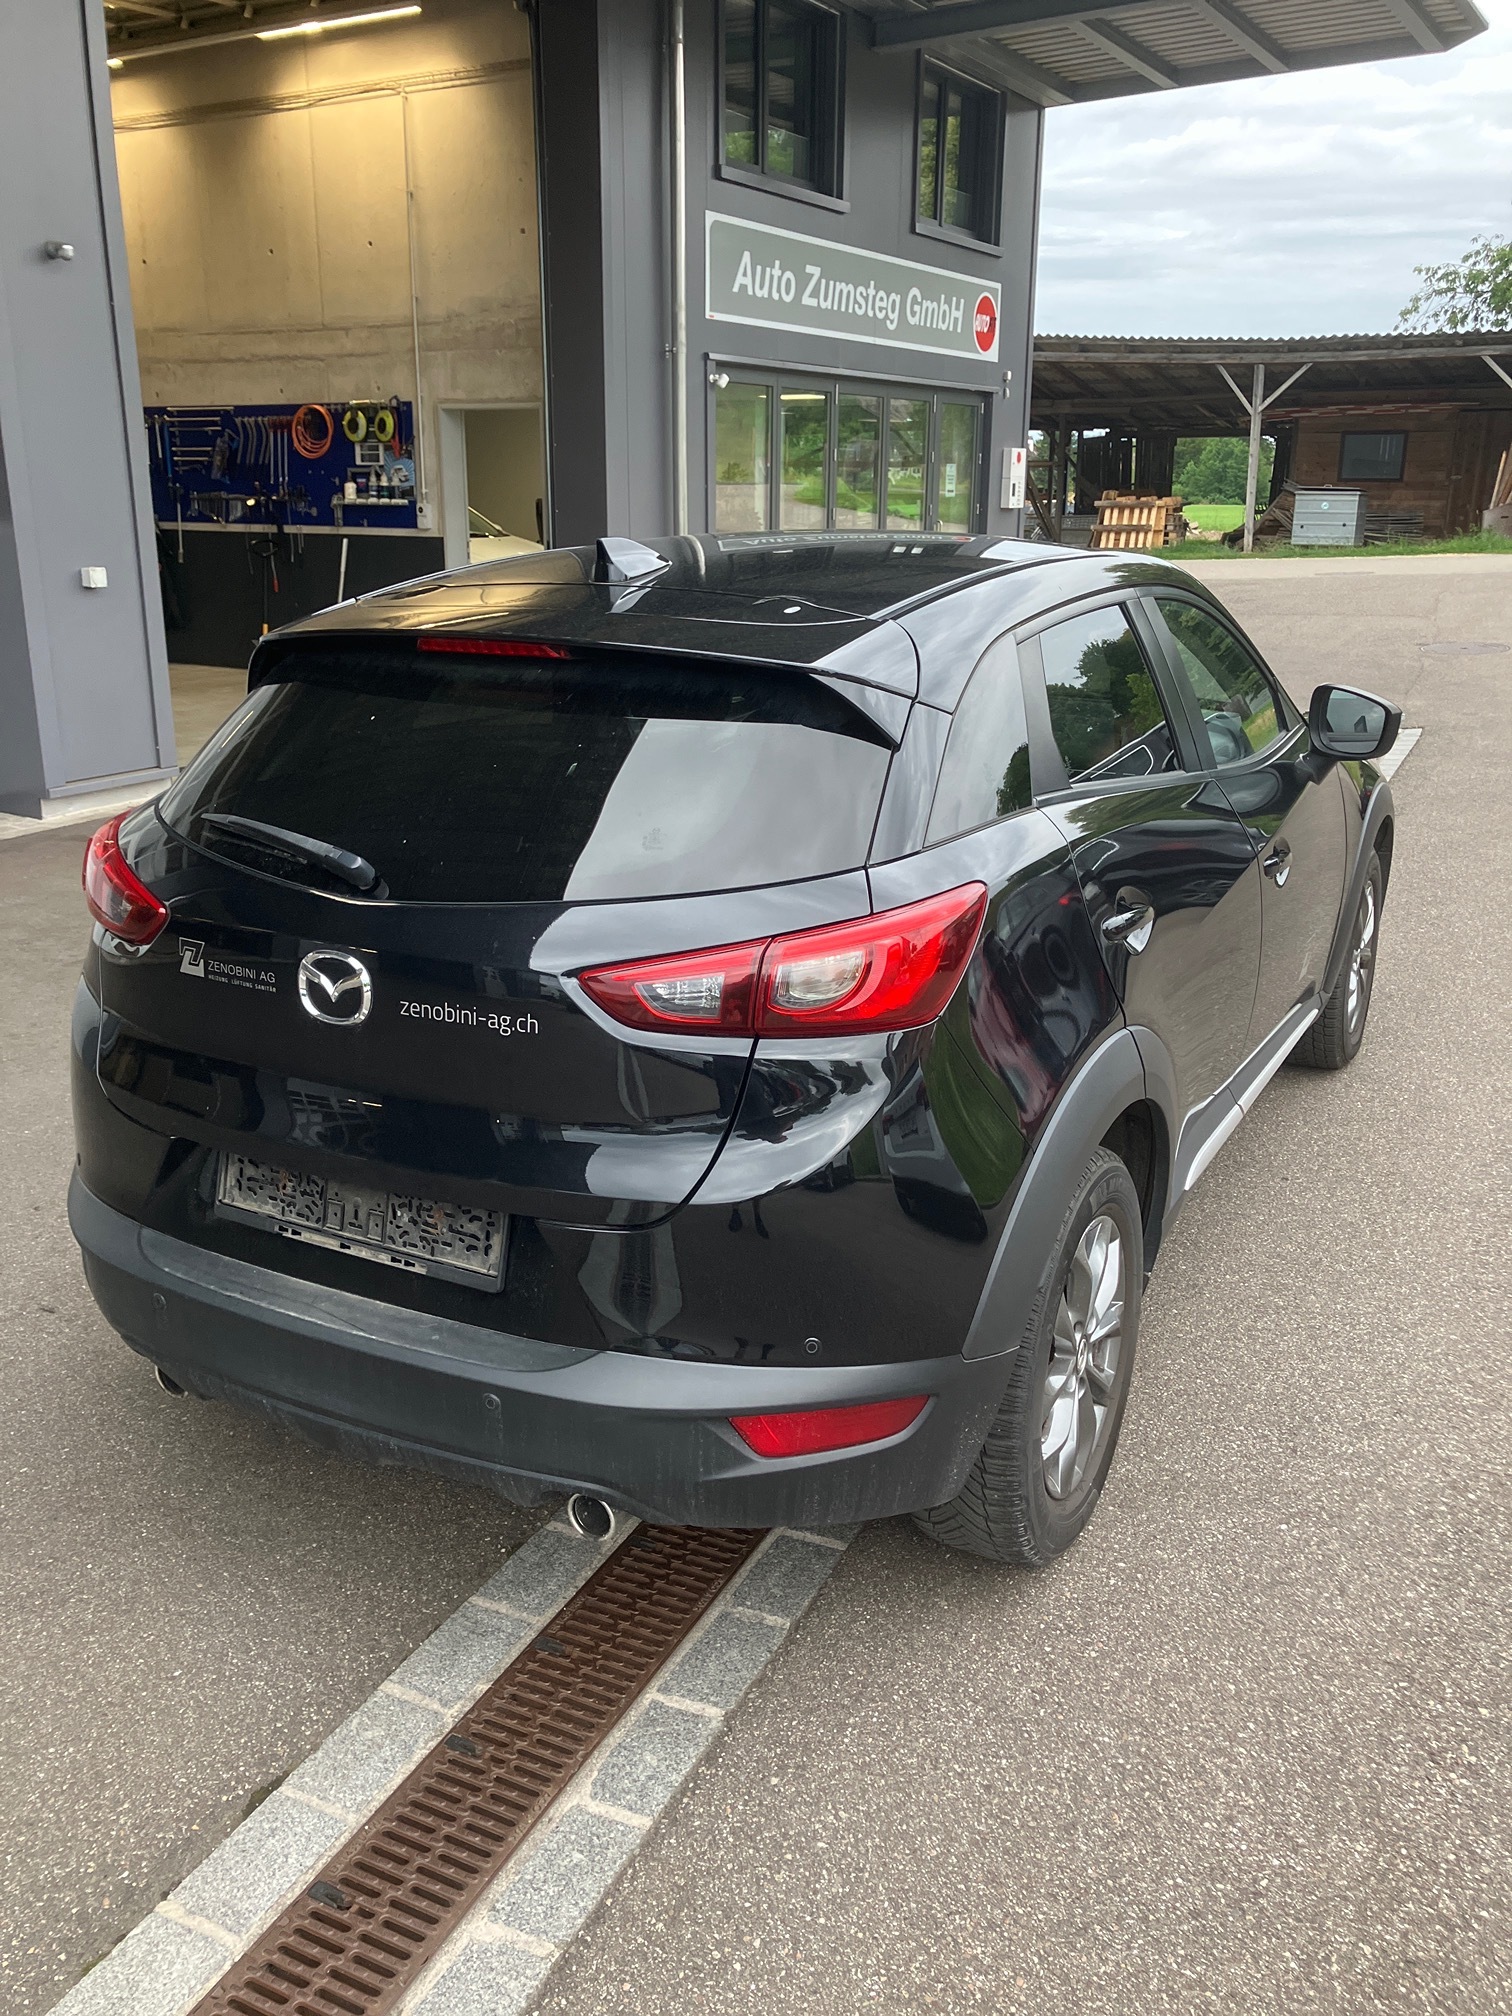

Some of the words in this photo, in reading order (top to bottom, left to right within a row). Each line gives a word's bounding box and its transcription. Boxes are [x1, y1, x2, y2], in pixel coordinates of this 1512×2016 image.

[732, 250, 796, 302] Auto
[802, 265, 900, 330] Zumsteg
[906, 287, 964, 333] GmbH
[208, 960, 256, 979] ZENOBINI
[260, 971, 276, 983] AG
[400, 1001, 539, 1036] zenobini-ag.ch
